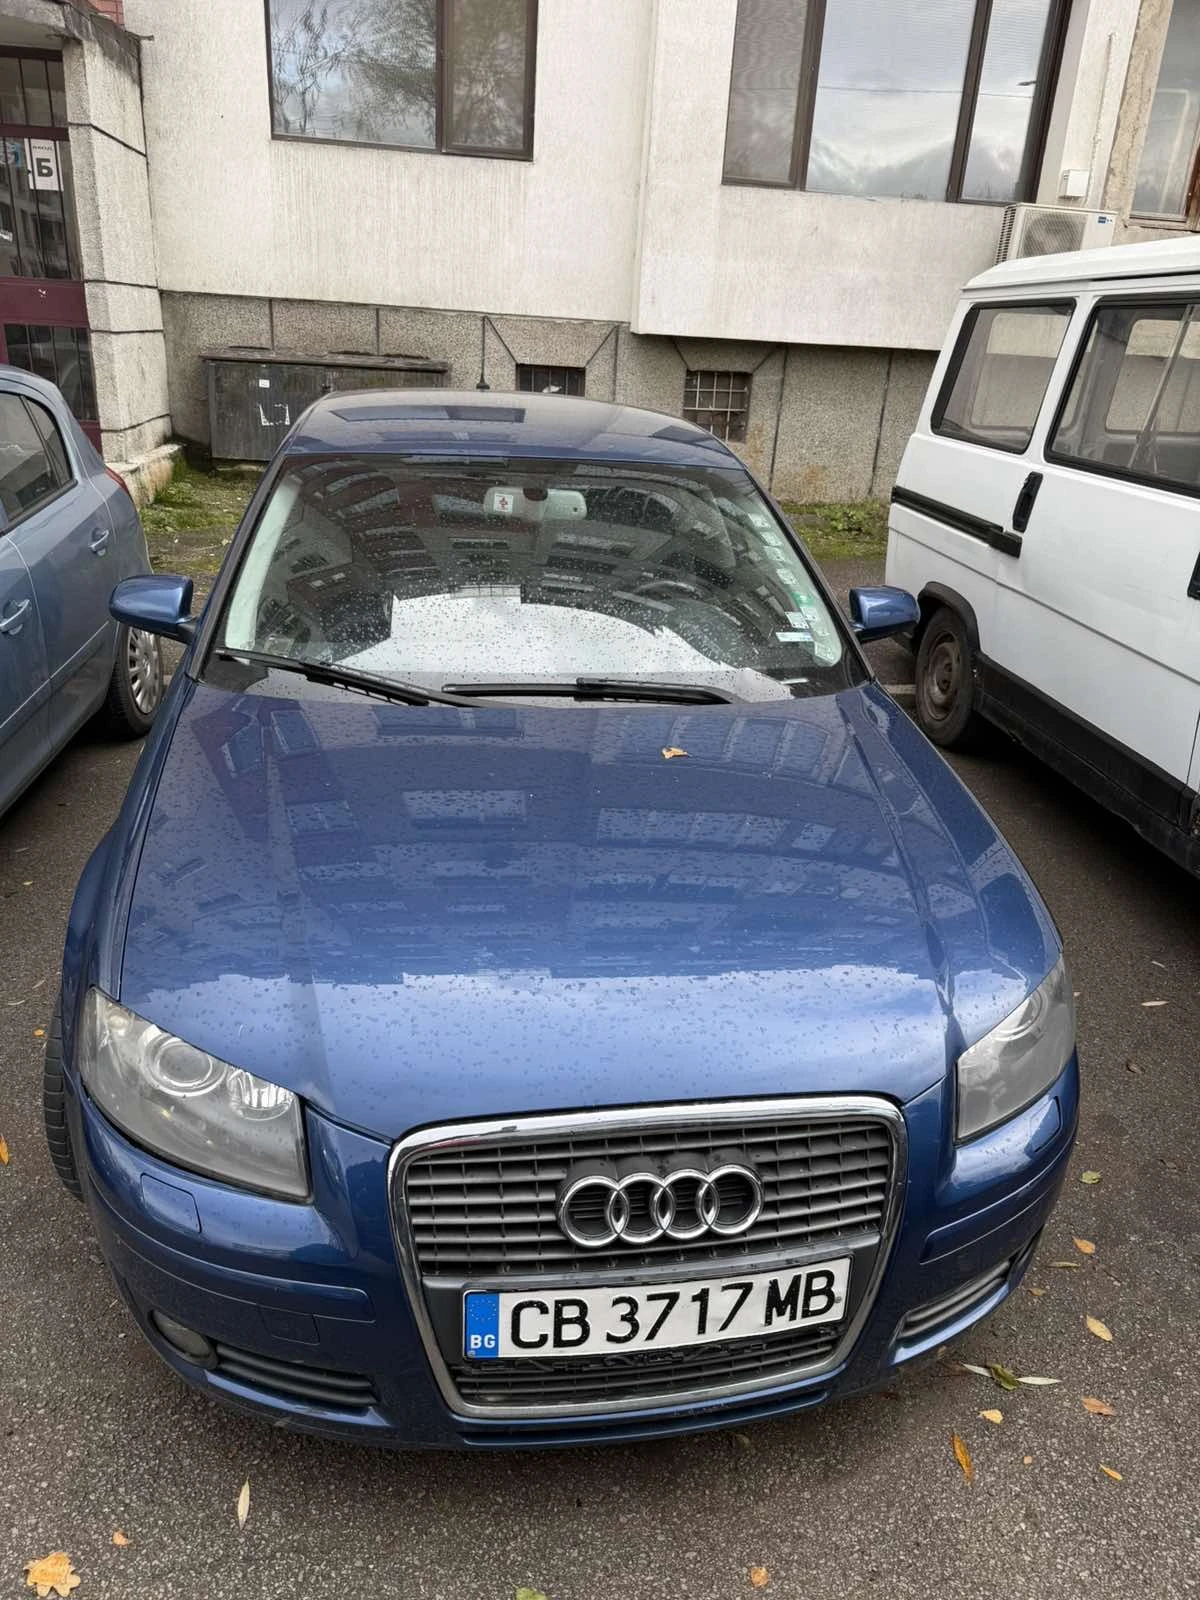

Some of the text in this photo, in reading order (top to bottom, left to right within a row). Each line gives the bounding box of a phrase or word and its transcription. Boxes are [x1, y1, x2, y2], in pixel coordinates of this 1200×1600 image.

[36, 158, 53, 177] Б
[511, 1269, 836, 1349] CB 3717 MB
[470, 1334, 496, 1349] BG
